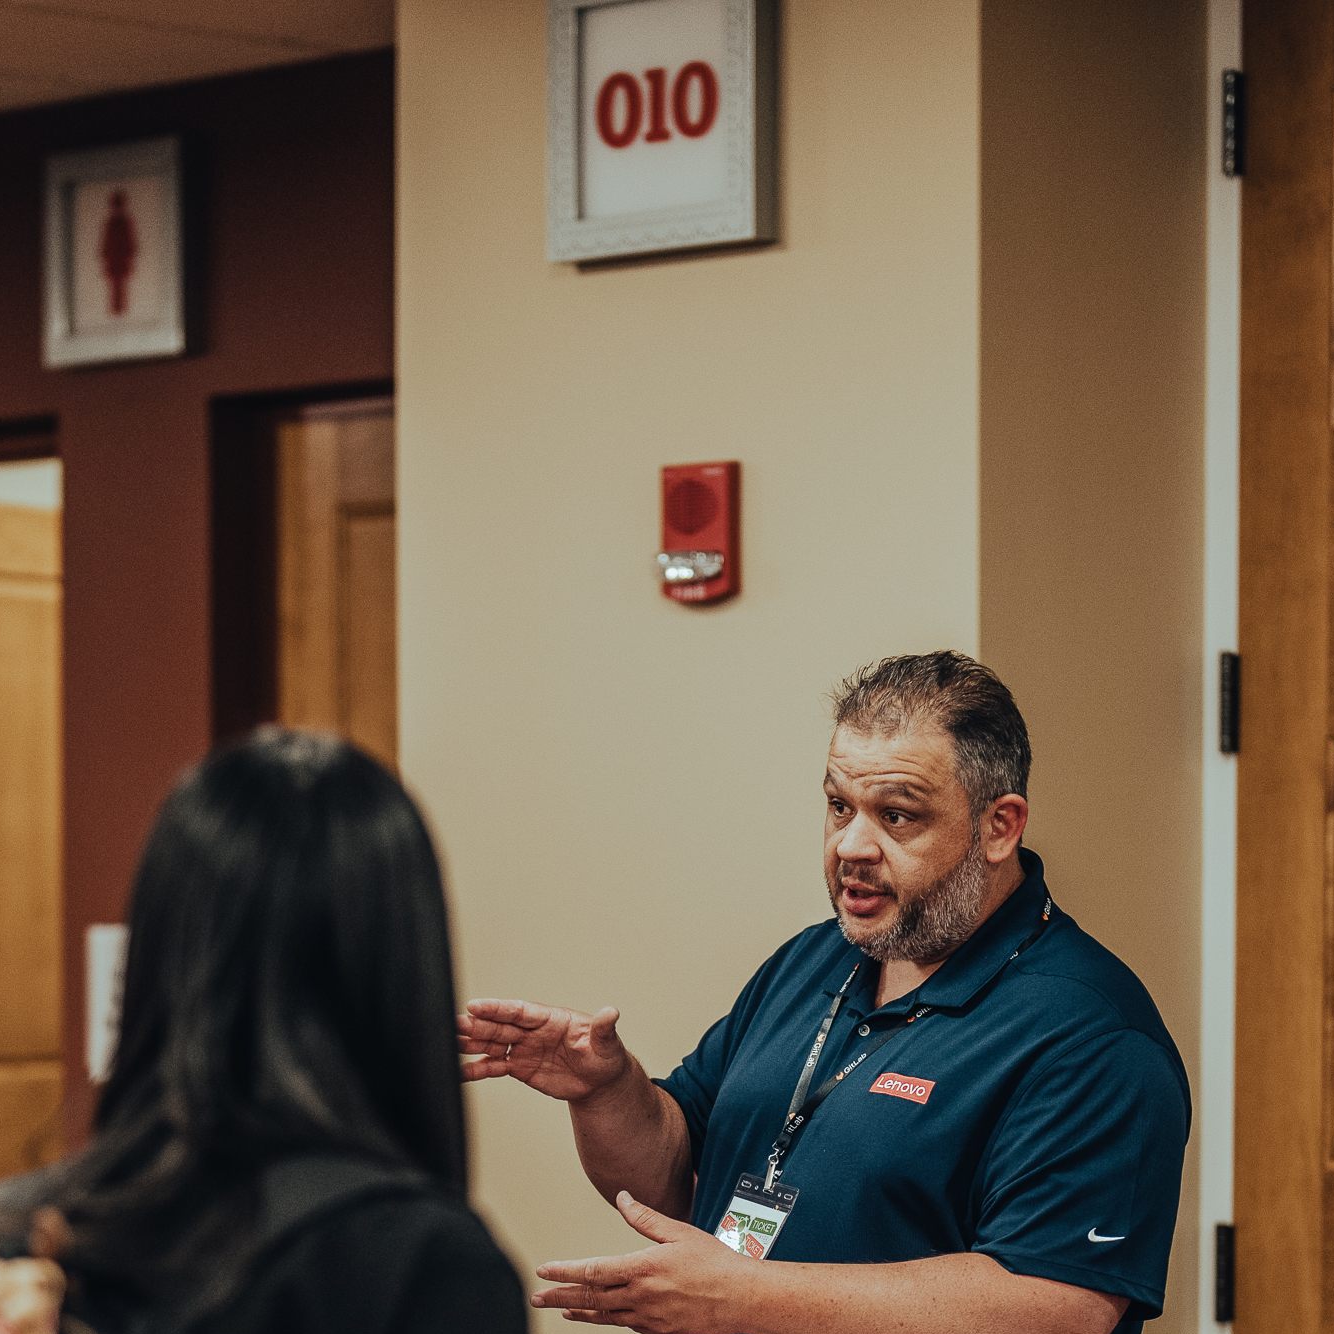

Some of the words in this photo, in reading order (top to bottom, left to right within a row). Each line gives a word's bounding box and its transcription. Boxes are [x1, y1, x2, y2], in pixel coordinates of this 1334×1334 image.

[595, 60, 719, 149] 010
[807, 1042, 822, 1068] GitLab
[843, 1053, 867, 1074] GitLab
[876, 1076, 926, 1097] Lenovo
[785, 1115, 805, 1134] itLab
[753, 1220, 775, 1233] TICKET
[746, 1237, 763, 1257] TICKET
